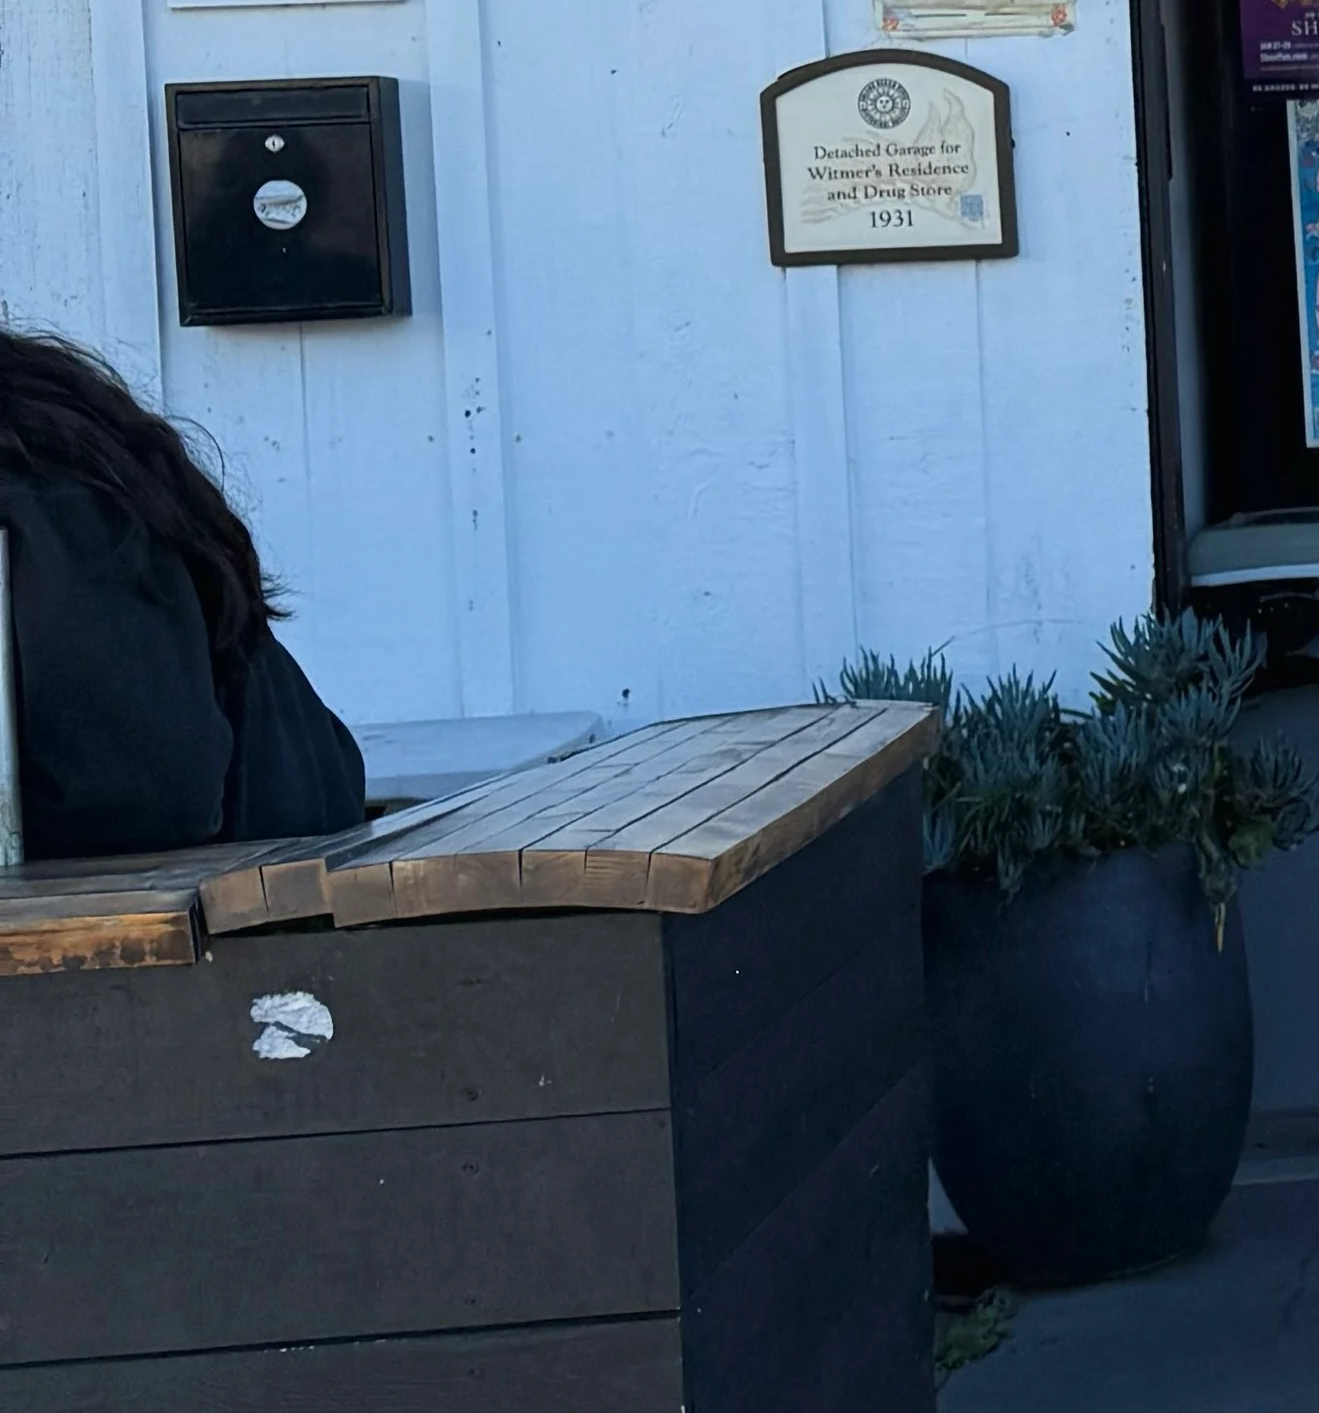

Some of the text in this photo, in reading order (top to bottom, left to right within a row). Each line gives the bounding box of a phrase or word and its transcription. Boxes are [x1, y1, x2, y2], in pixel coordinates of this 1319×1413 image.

[813, 140, 962, 161] Detached Garage for
[807, 162, 969, 181] Witmer's Residence
[827, 183, 953, 202] and Drug Store
[869, 209, 915, 229] 1931
